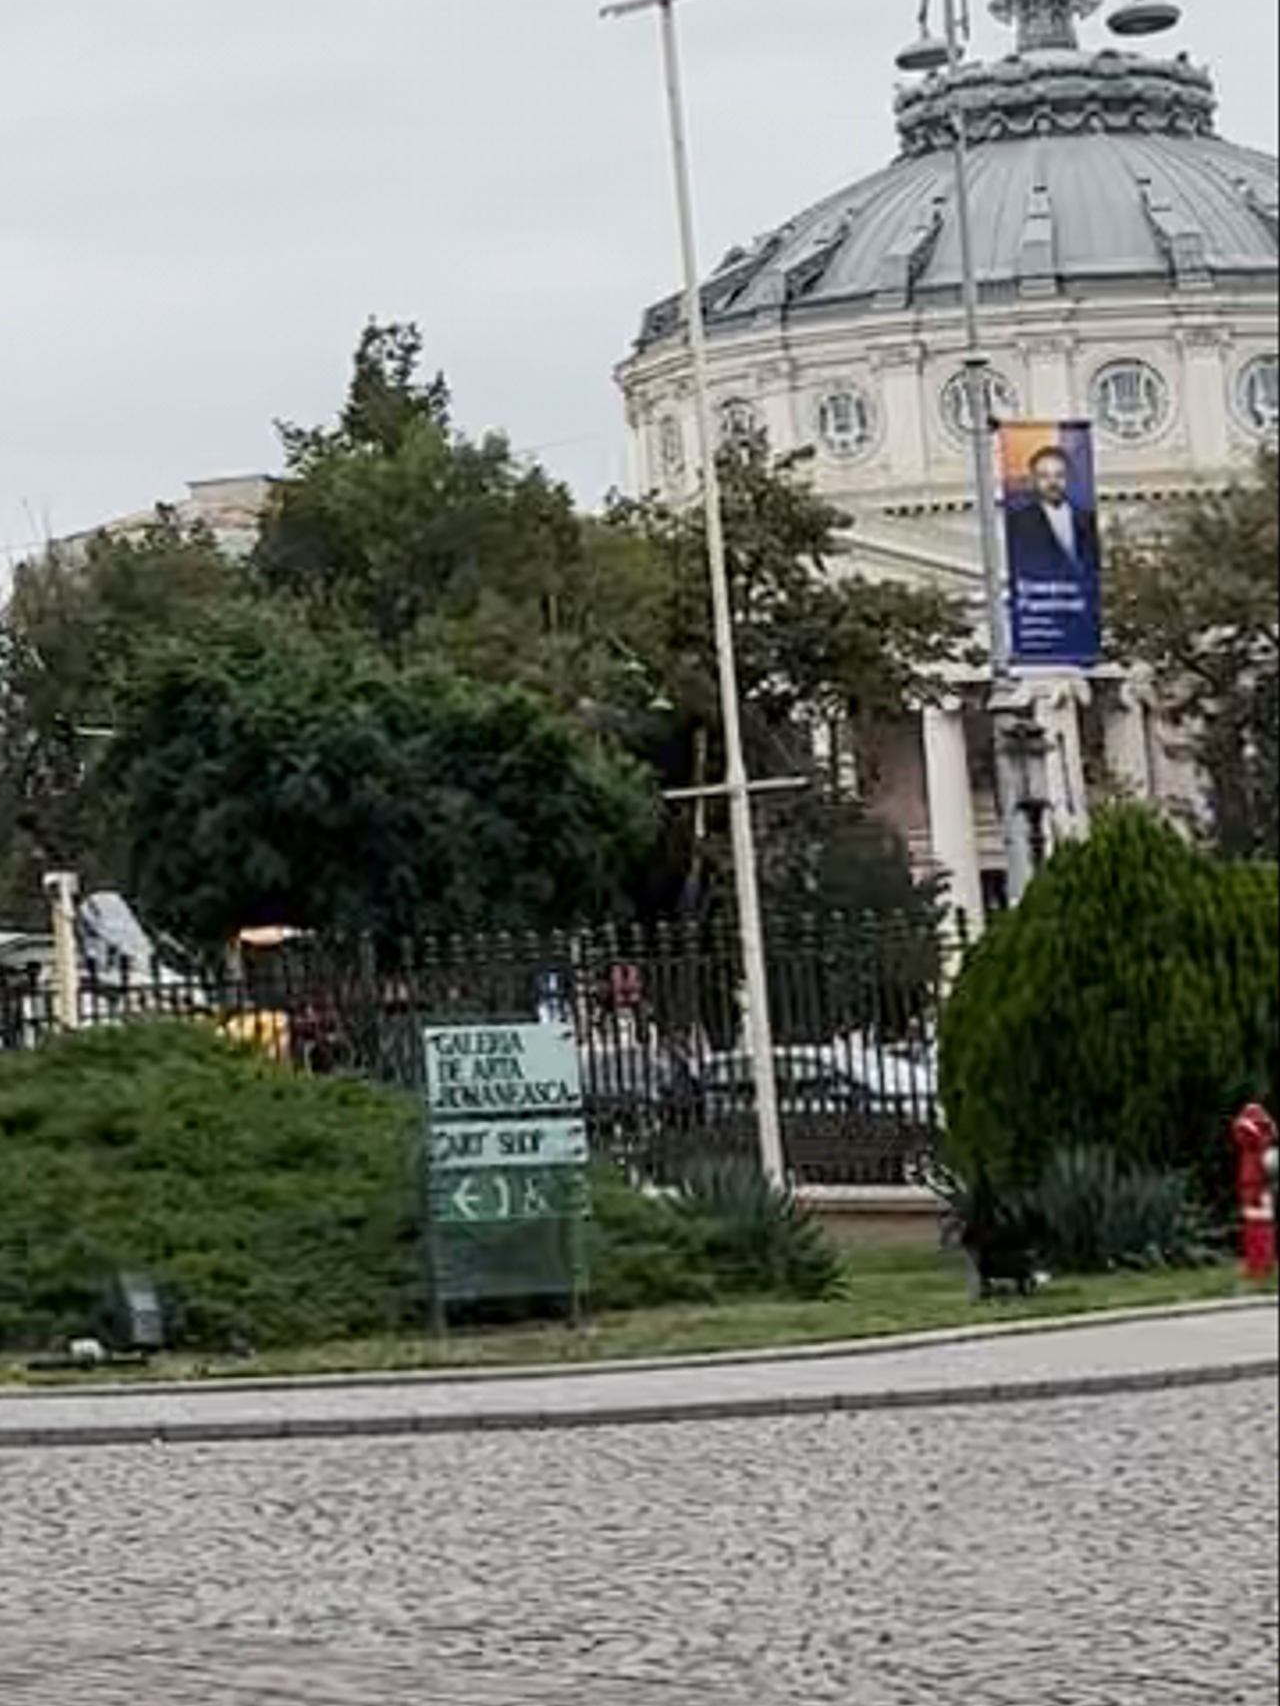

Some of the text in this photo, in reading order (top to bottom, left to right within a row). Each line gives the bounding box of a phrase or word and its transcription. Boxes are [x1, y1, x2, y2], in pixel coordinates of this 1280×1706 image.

[437, 1031, 525, 1055] GALERIA
[439, 1059, 462, 1082] DE
[446, 1129, 544, 1156] ART SHOP
